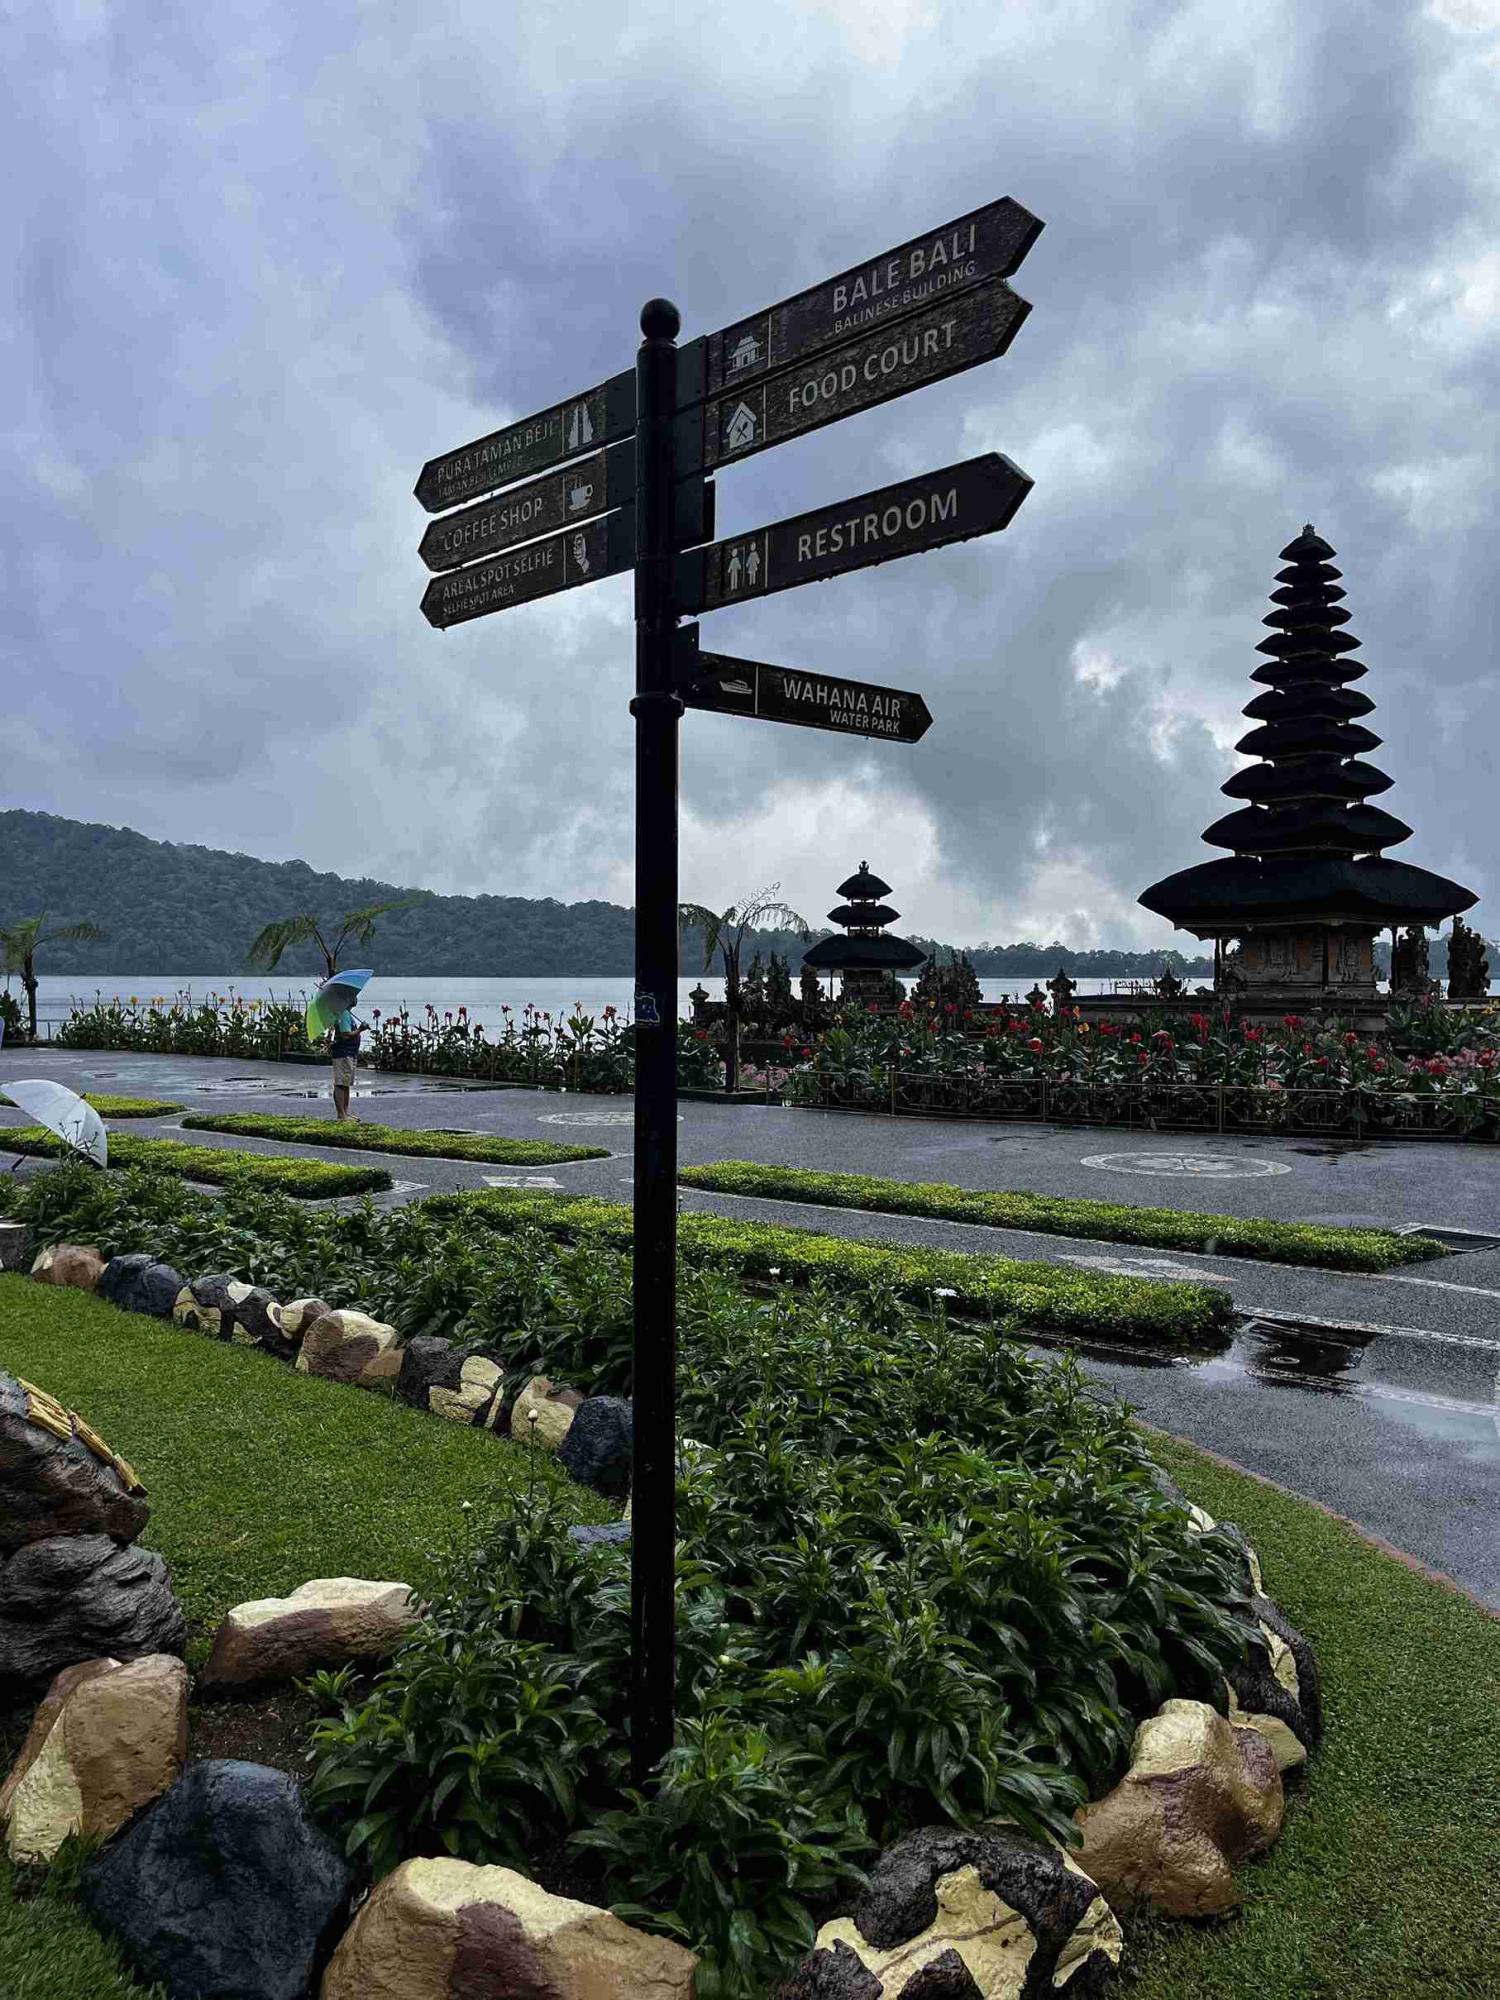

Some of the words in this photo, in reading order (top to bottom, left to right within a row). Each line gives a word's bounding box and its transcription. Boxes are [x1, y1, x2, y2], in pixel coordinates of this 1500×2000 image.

[832, 259, 901, 313] BALE
[909, 224, 978, 279] BALI
[834, 298, 900, 334] BALINESE
[902, 260, 977, 304] BUILDING
[788, 365, 857, 413] FOOD
[863, 320, 958, 380] COURT
[437, 456, 471, 483] PURA
[473, 435, 522, 467] TAMAN
[442, 514, 497, 551] COFFEE
[500, 497, 543, 530] SHOP
[798, 488, 959, 562] RESTROOM
[443, 575, 479, 600] AREAL
[481, 563, 511, 588] SPOT
[513, 548, 554, 576] SELFIE
[443, 600, 468, 616] SELFIE
[469, 592, 490, 608] SPOT
[491, 584, 515, 601] AREA
[782, 677, 868, 712] WAHANA
[871, 697, 901, 718] AIR
[829, 709, 870, 729] WATER
[871, 714, 900, 734] PARK
